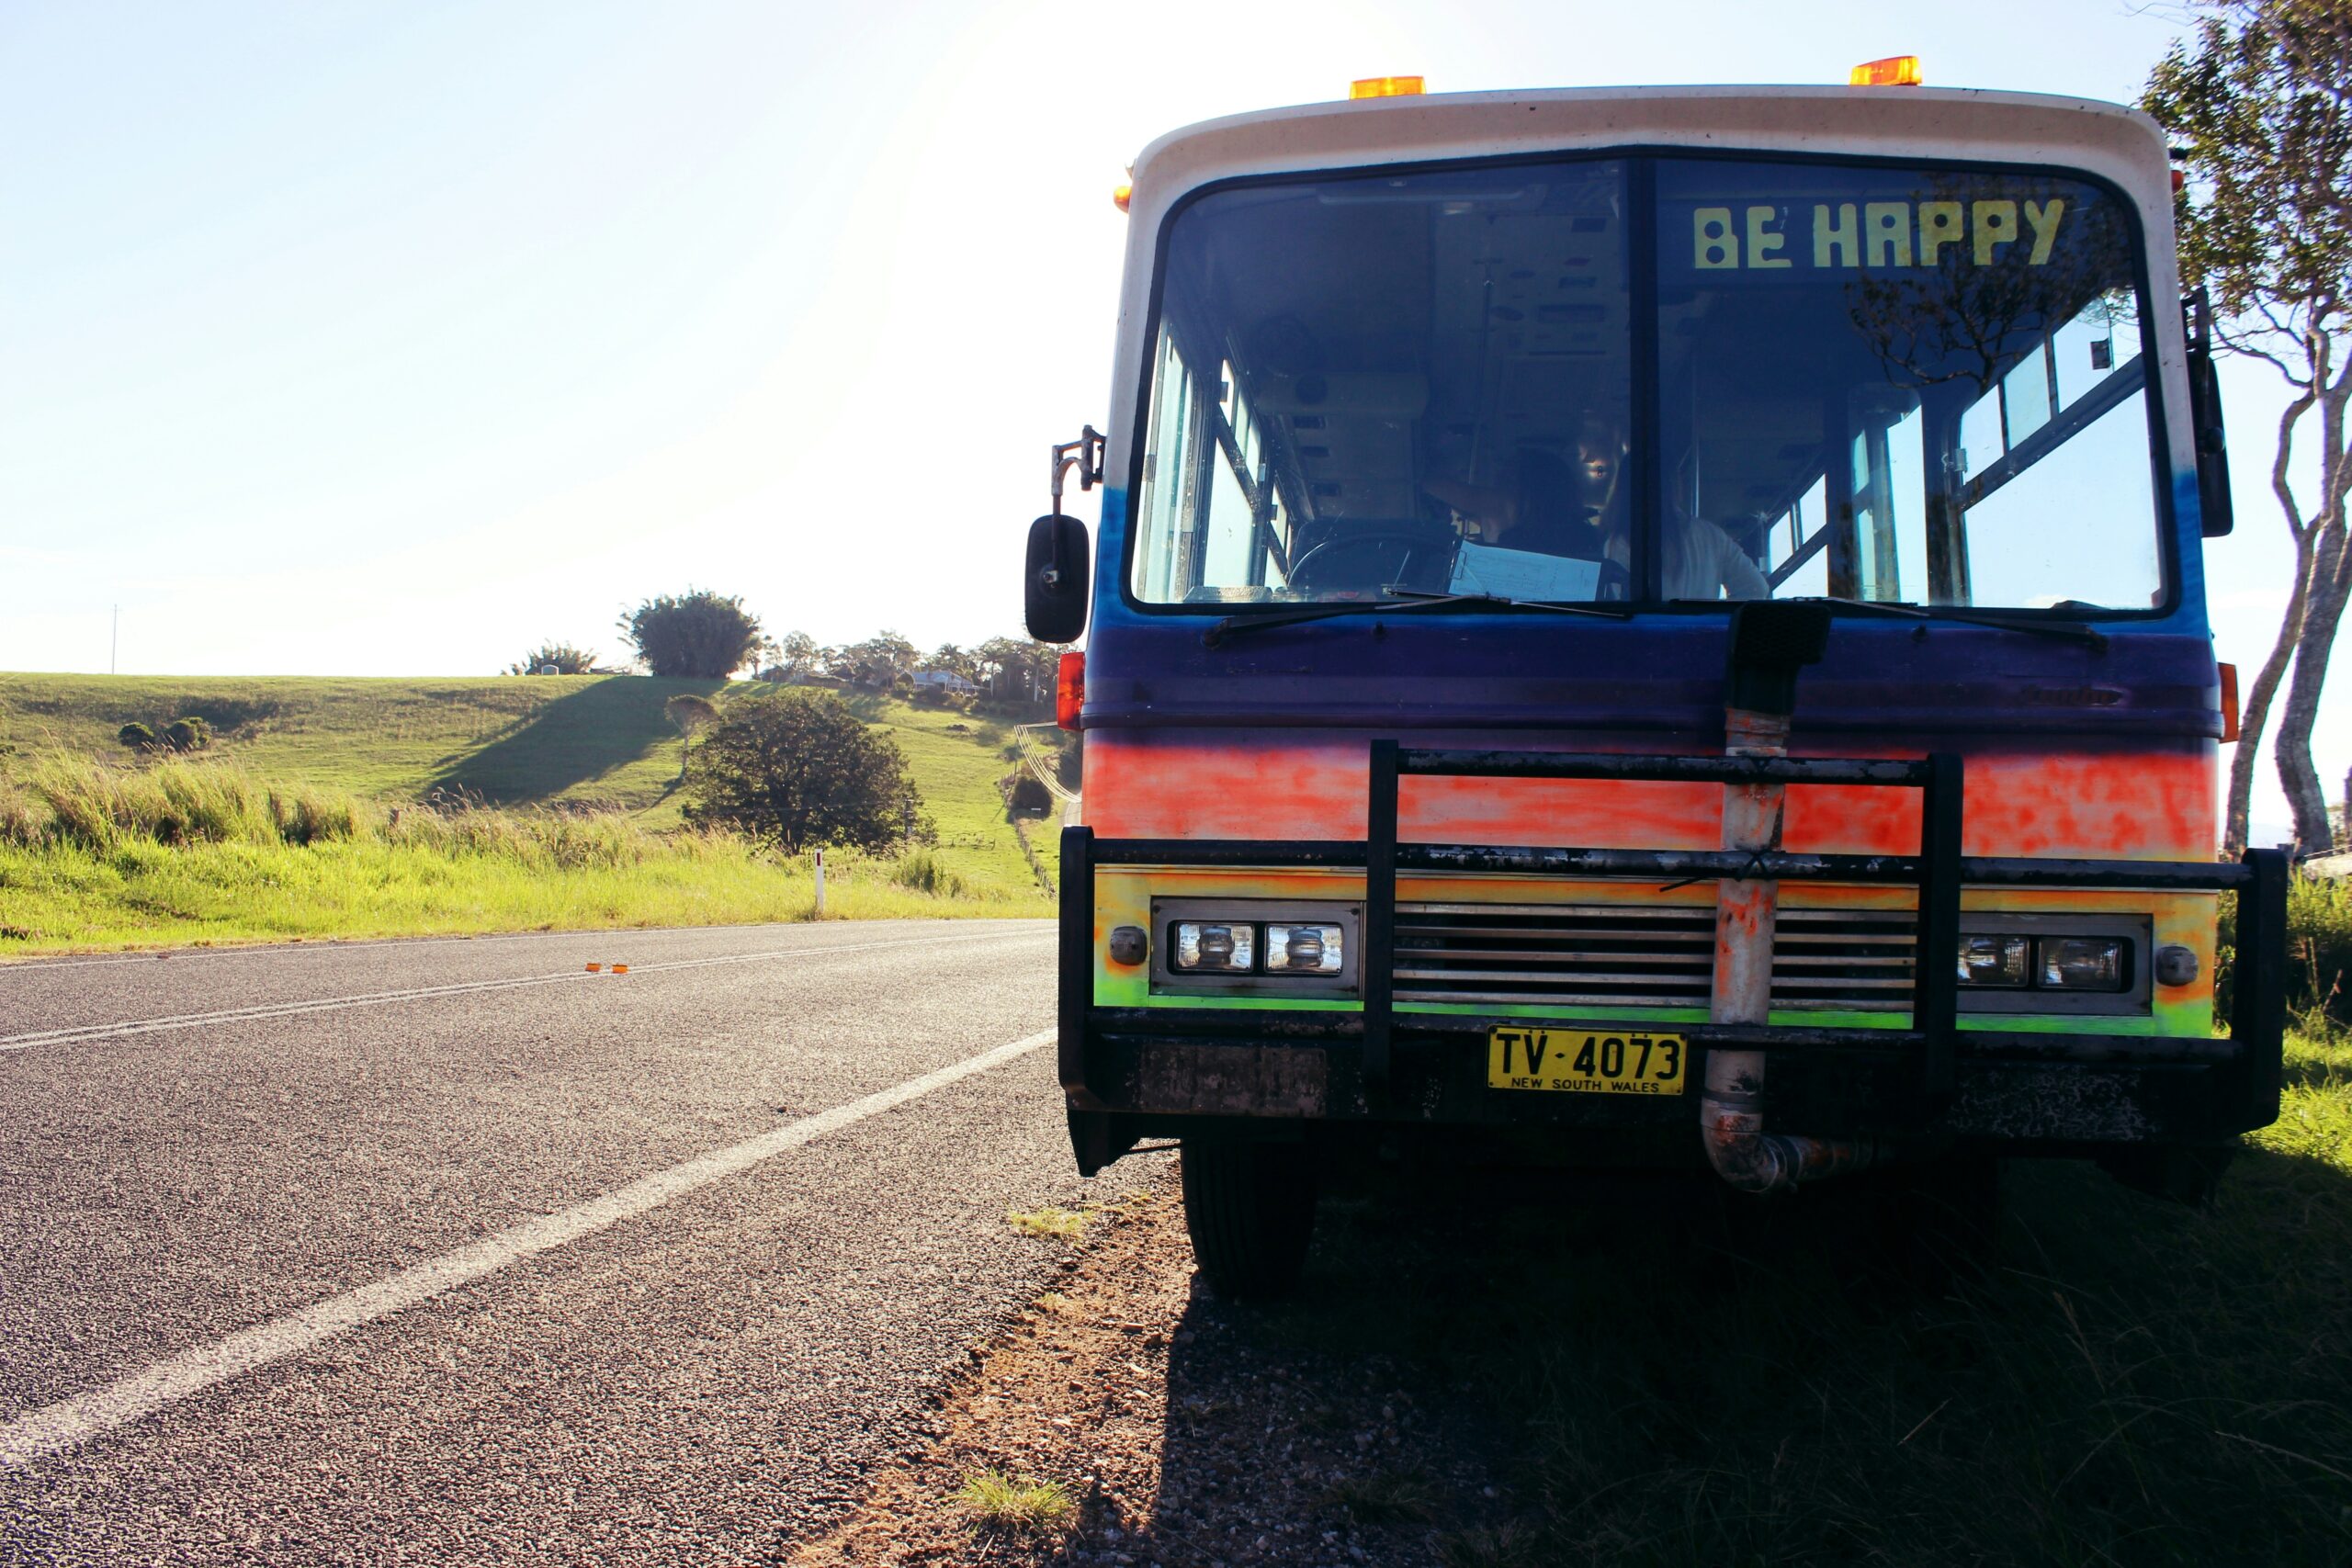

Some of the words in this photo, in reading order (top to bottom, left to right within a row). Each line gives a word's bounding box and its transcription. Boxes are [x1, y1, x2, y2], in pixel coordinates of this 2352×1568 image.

[1693, 206, 1792, 269] BE
[1813, 198, 2064, 267] HAPPY
[1511, 1077, 1543, 1089] NEW
[1553, 1079, 1601, 1090] SOUTH
[1611, 1082, 1659, 1093] WALES
